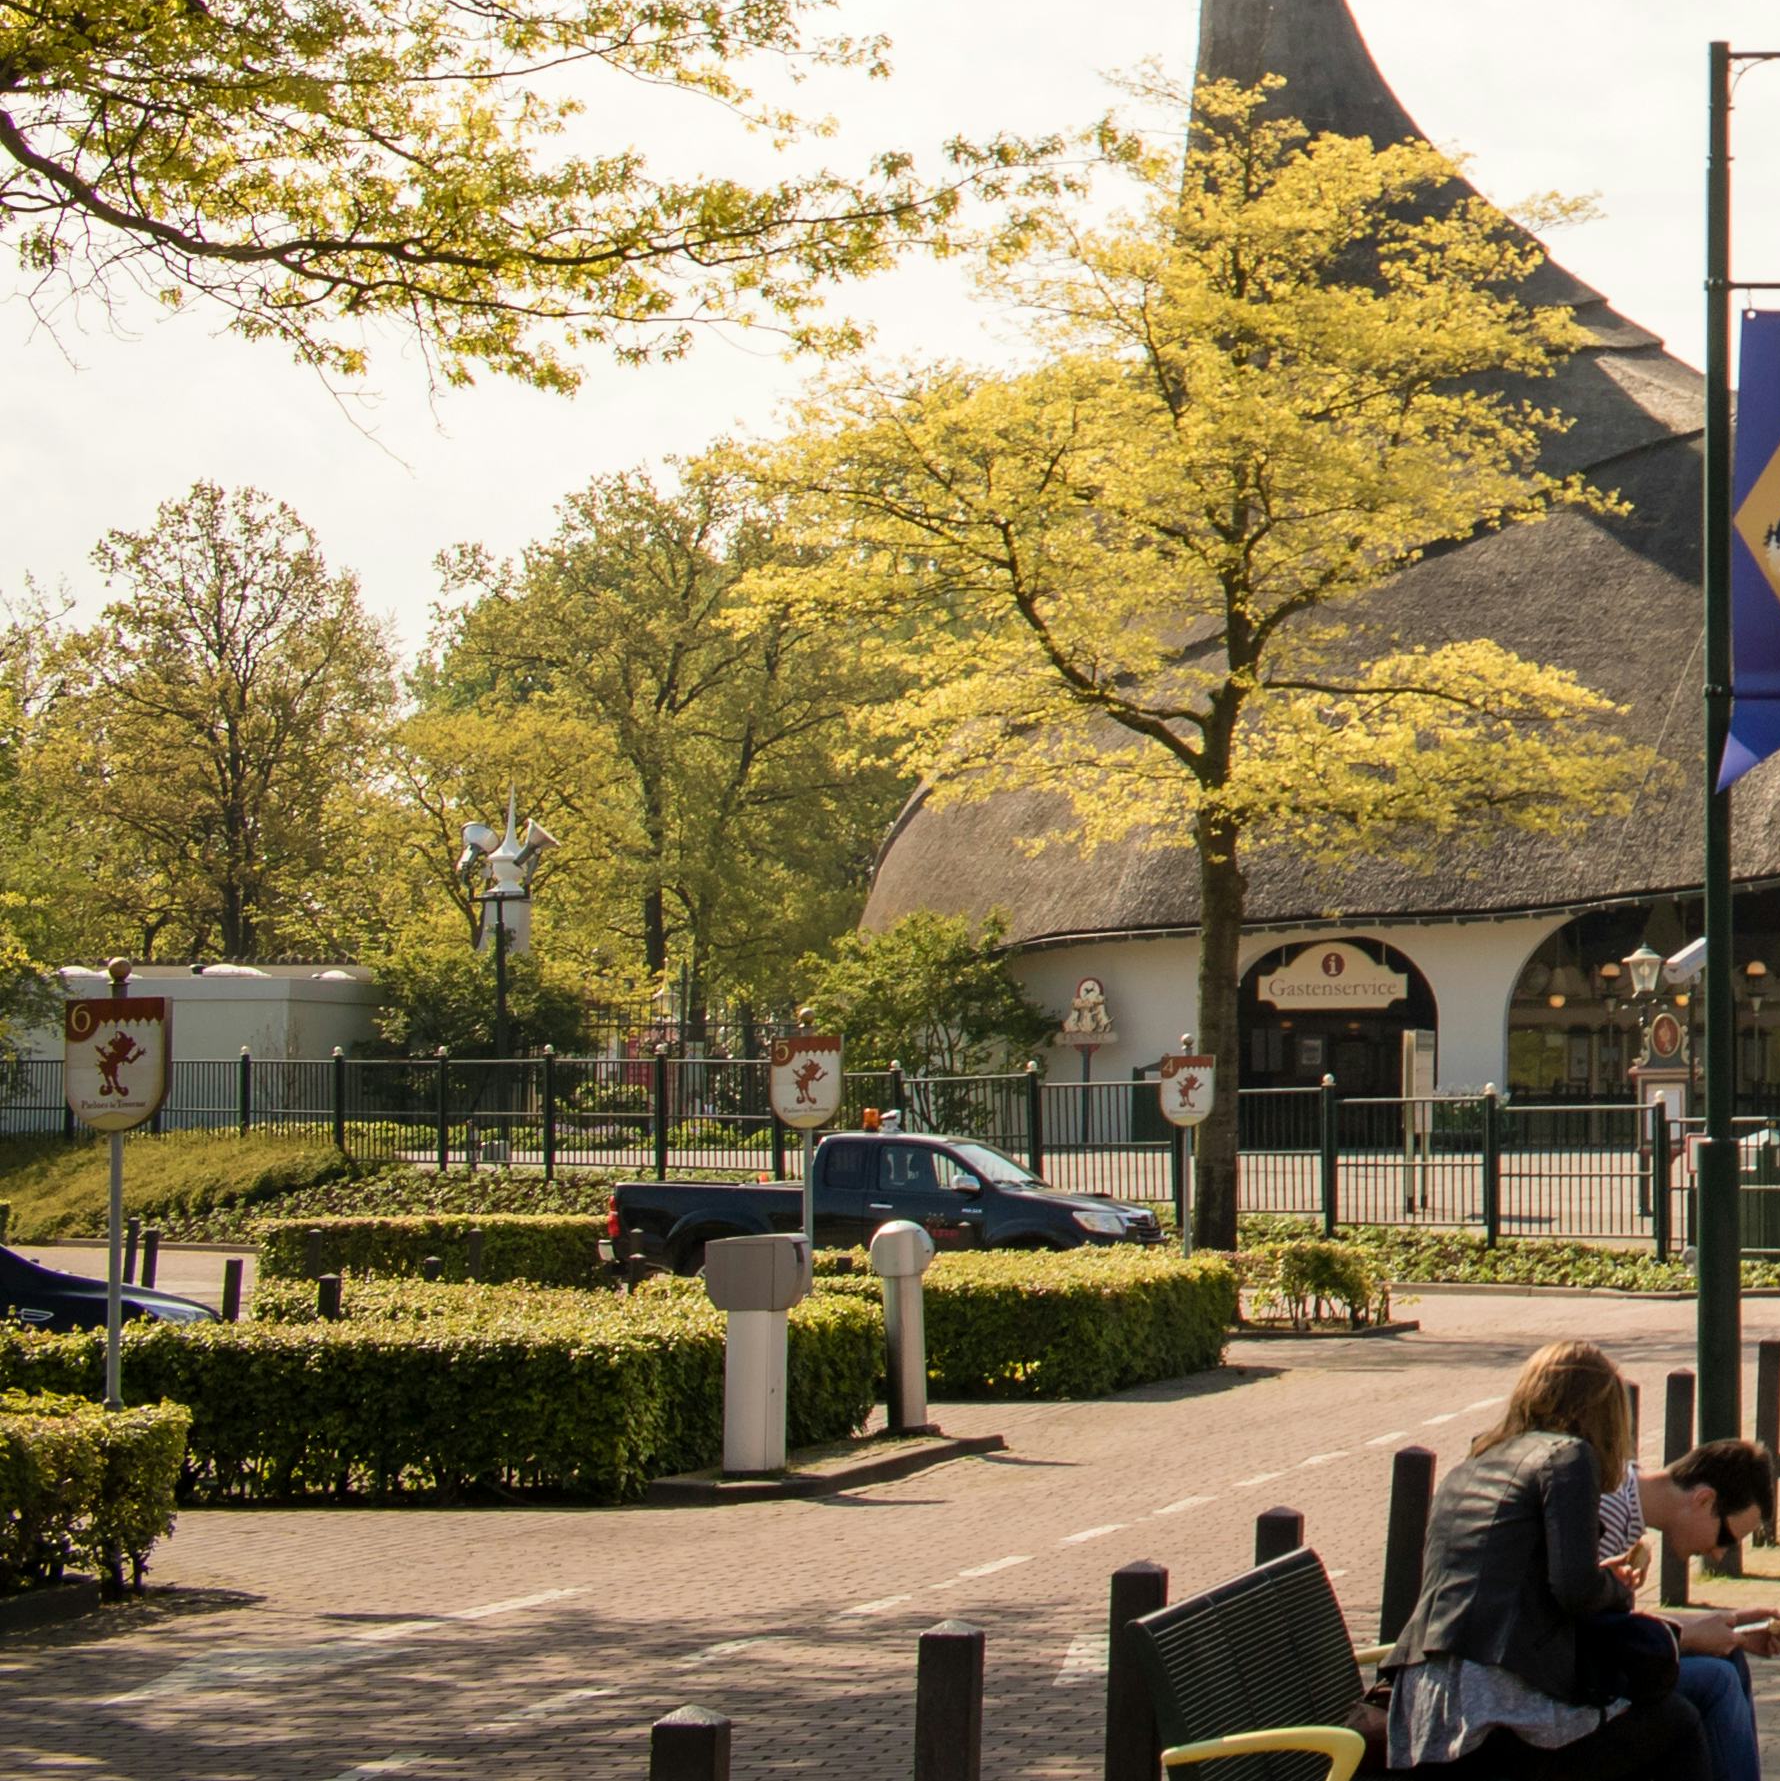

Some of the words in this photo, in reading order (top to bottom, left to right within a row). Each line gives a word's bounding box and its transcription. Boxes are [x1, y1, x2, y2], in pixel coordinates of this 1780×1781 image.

[1268, 977, 1397, 997] Gastenservice
[71, 1003, 92, 1033] 6
[775, 1039, 789, 1061] 5
[1162, 1058, 1174, 1074] 4
